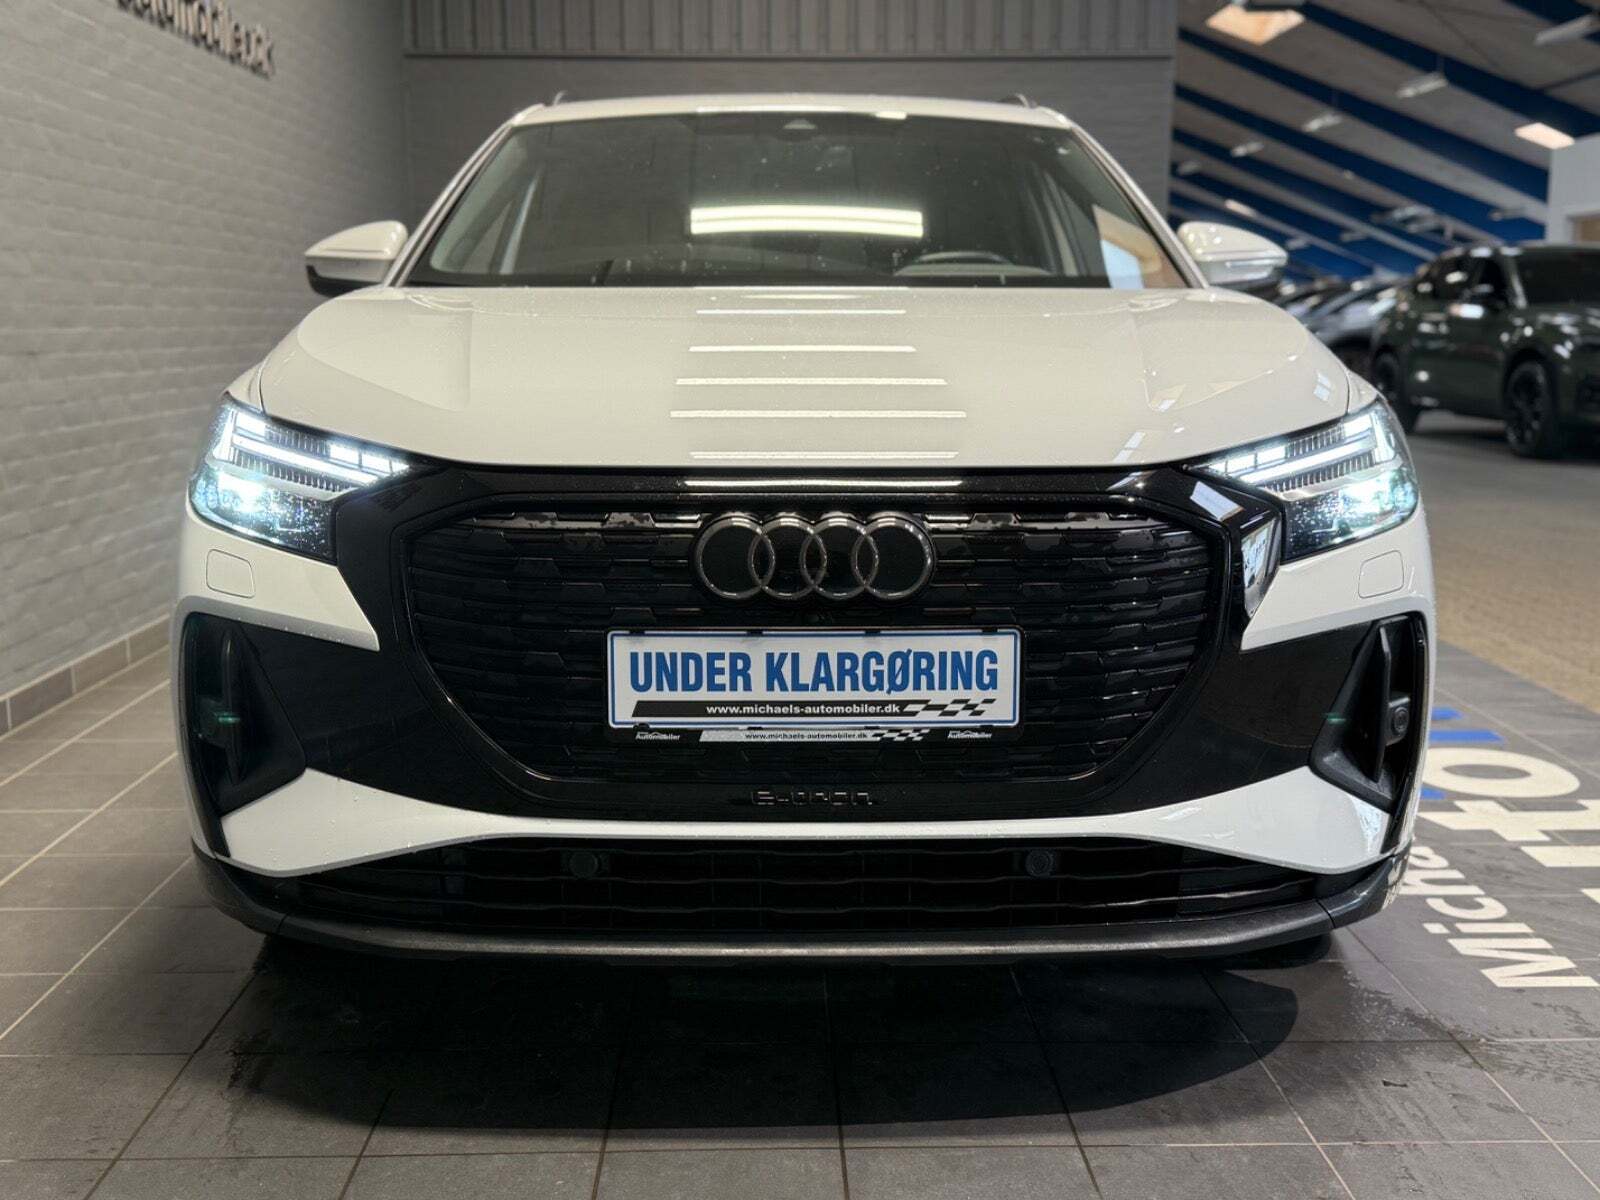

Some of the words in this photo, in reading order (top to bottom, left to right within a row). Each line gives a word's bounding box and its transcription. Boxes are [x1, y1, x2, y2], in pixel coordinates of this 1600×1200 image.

[629, 651, 753, 693] UNDER
[765, 649, 999, 694] KLARGØRING
[705, 703, 901, 716] www.michaels-automobiler.dk
